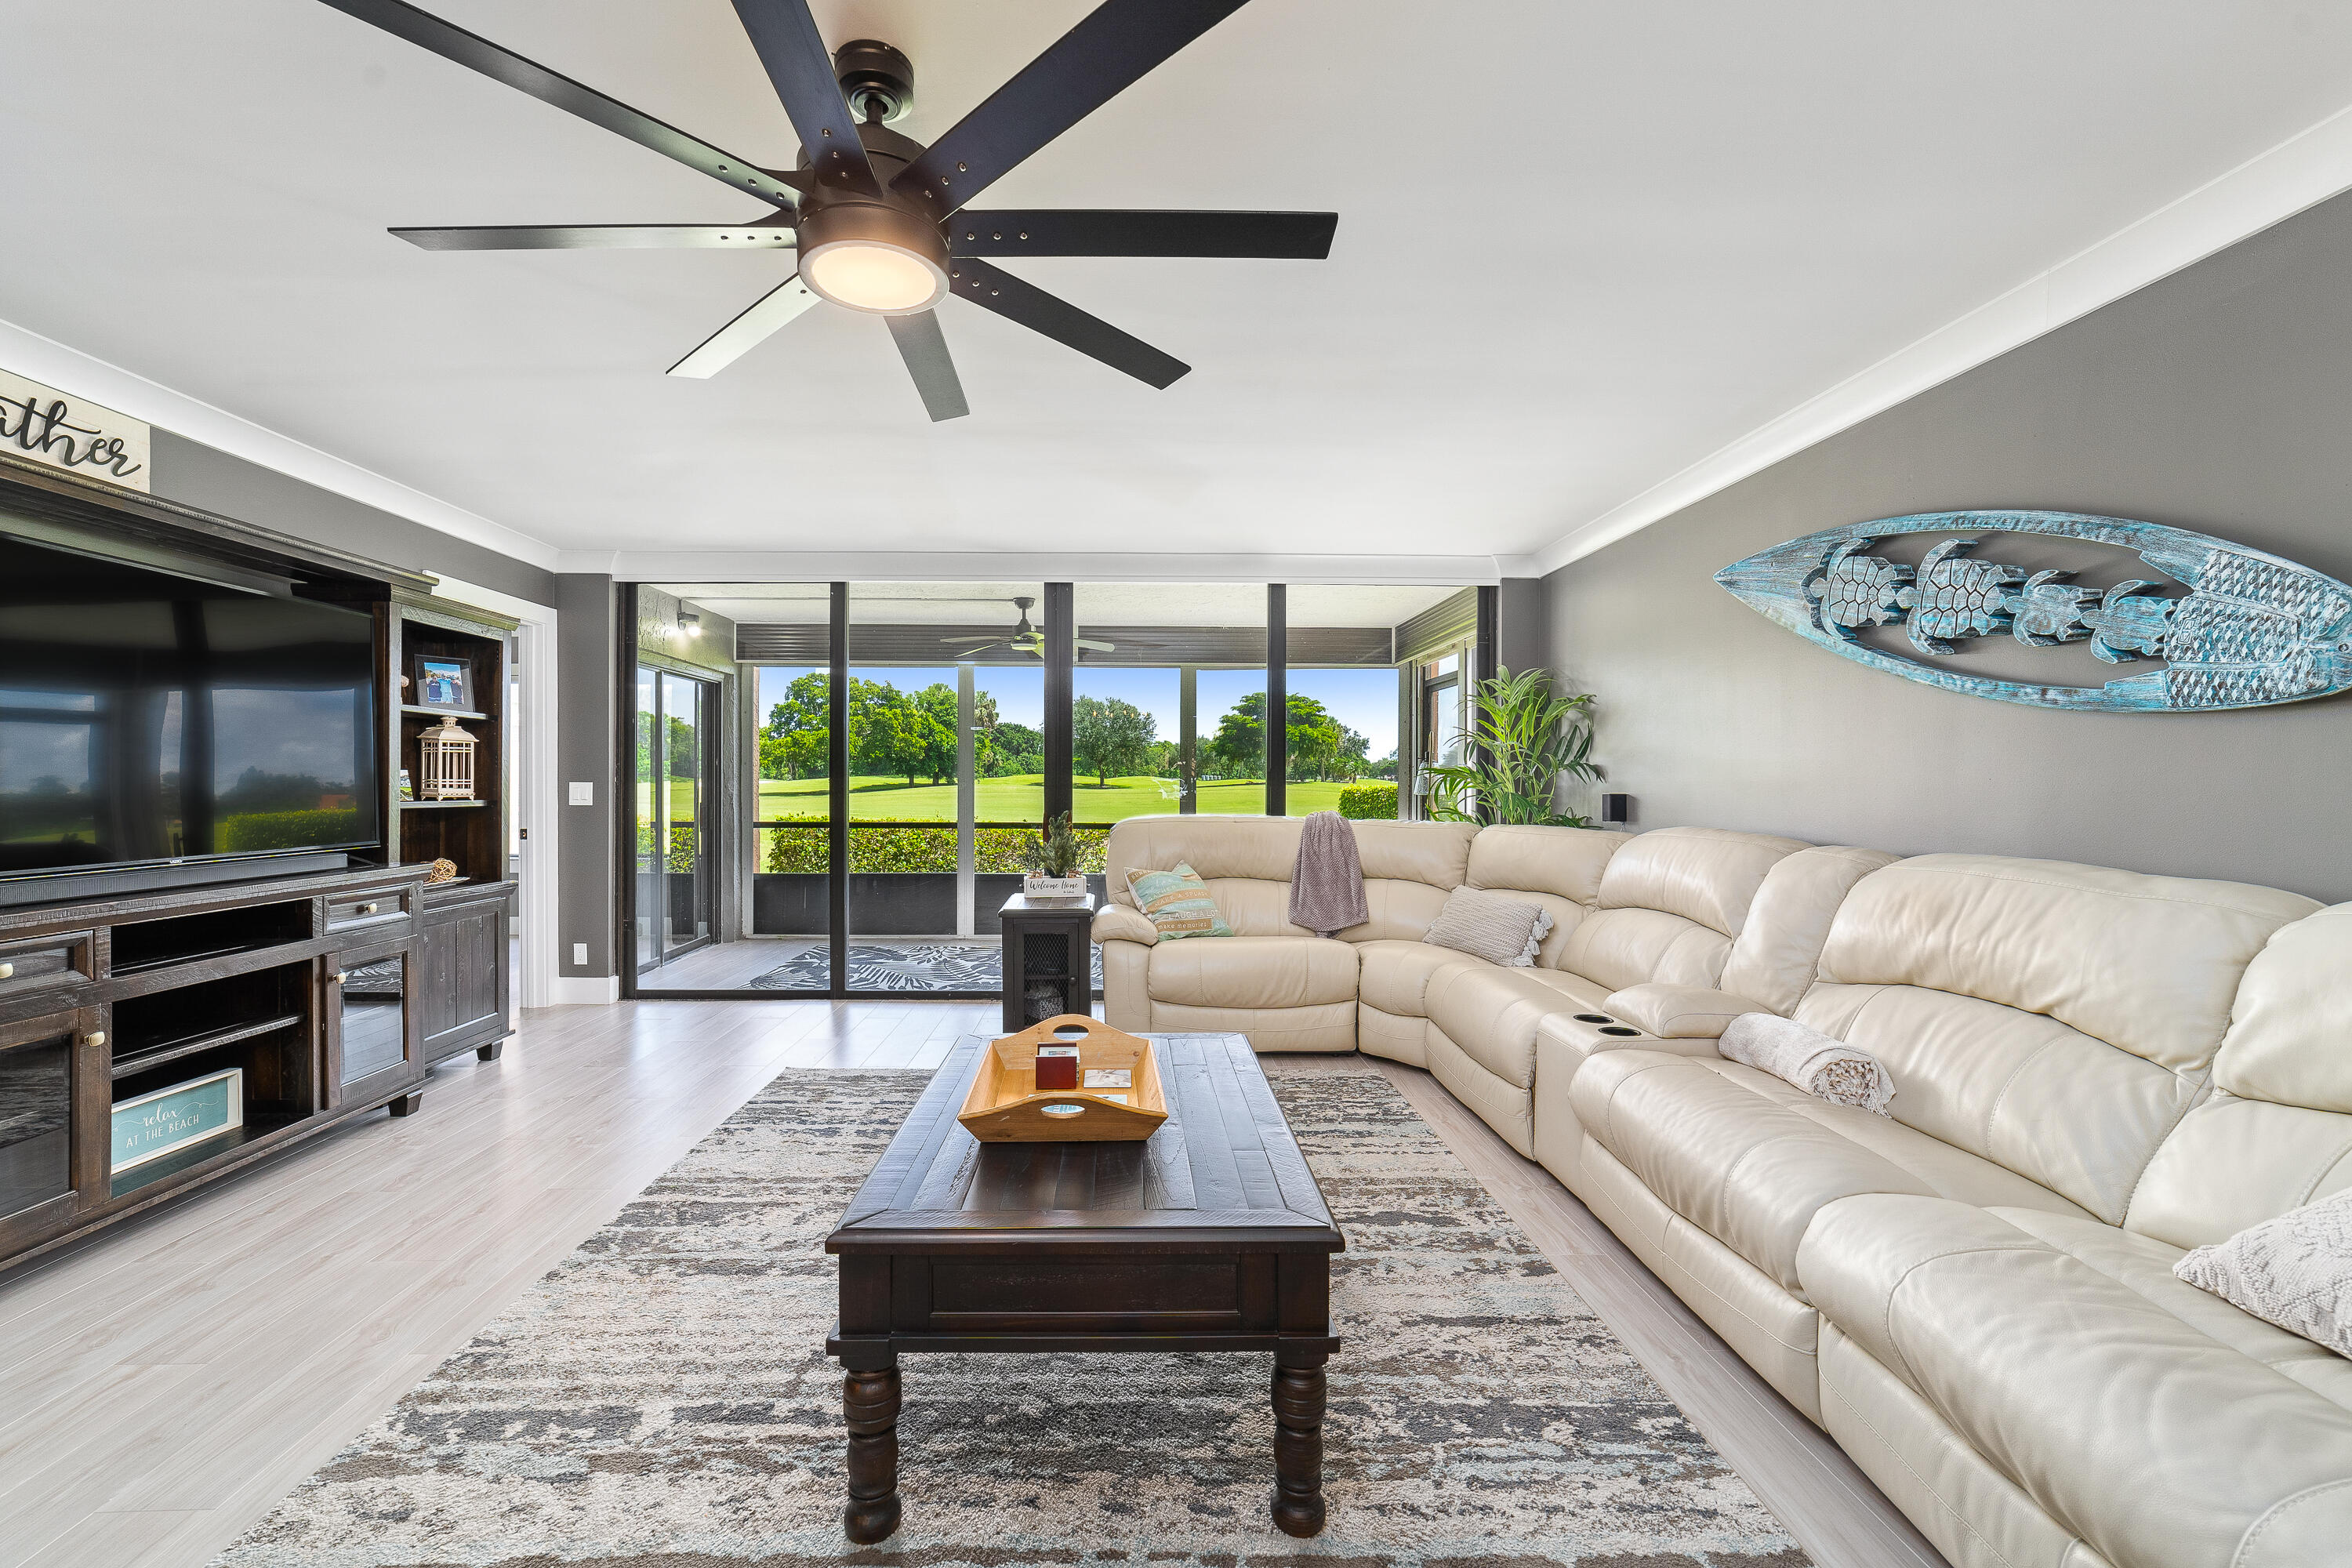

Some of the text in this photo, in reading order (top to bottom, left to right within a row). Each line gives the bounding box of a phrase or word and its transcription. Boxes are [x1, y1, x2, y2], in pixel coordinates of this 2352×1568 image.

[1029, 880, 1079, 890] Welcome Home
[1168, 910, 1197, 920] LAUGH
[126, 1113, 200, 1149] AT THE BEACH
